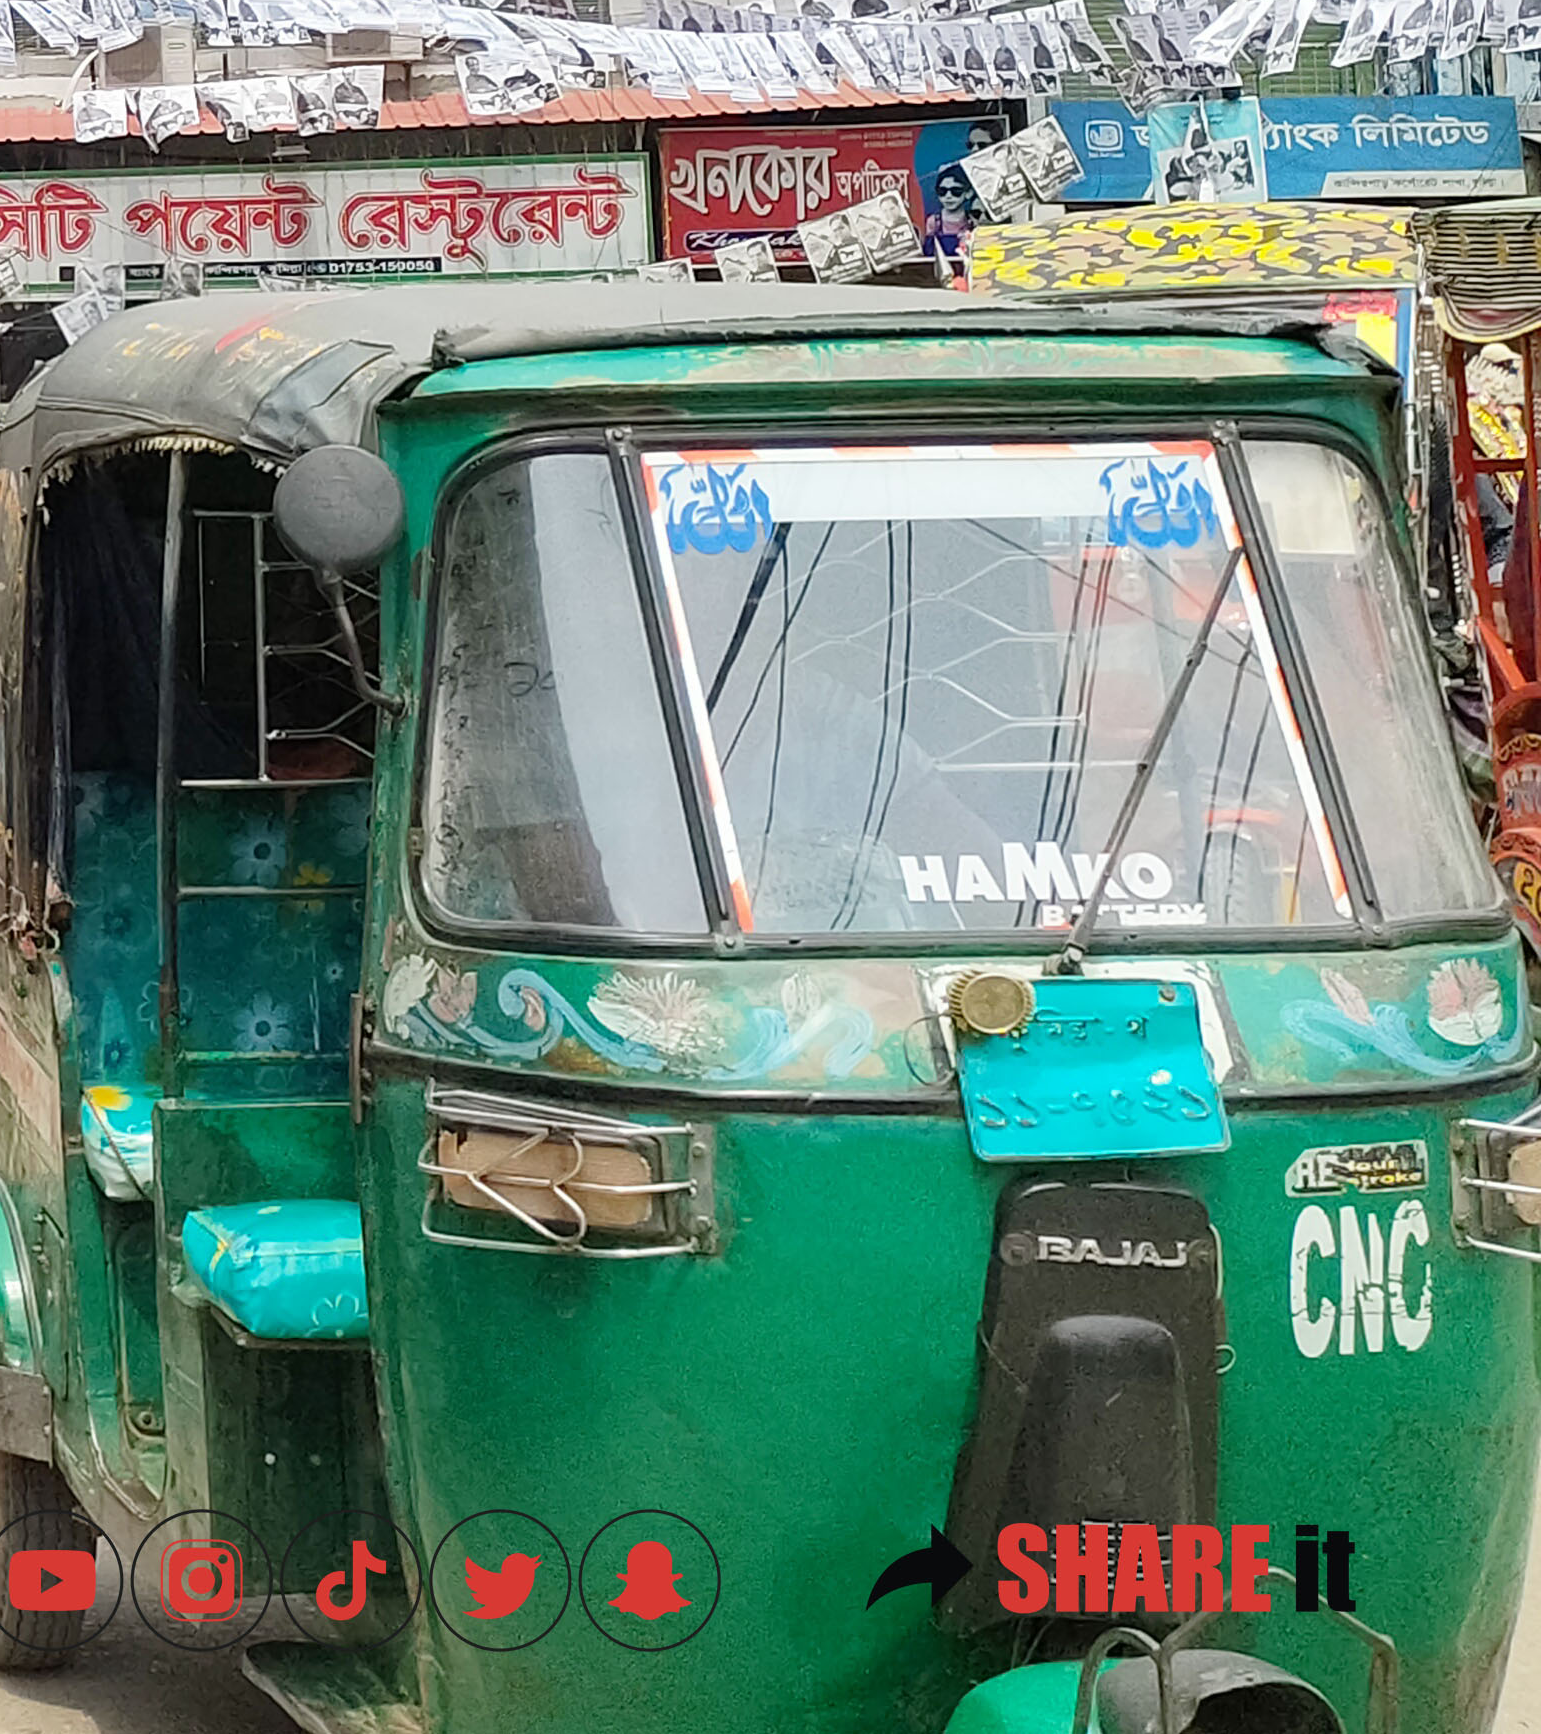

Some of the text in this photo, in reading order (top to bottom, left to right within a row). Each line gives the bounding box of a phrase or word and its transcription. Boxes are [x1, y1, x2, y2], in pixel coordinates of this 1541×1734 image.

[1351, 113, 1491, 150] লিমিটেড
[123, 172, 324, 258] পয়েন্ট
[340, 164, 638, 276] রেস্টুরেন্ট
[898, 841, 1173, 902] HAMKO
[1038, 1235, 1187, 1268] BAJAJ
